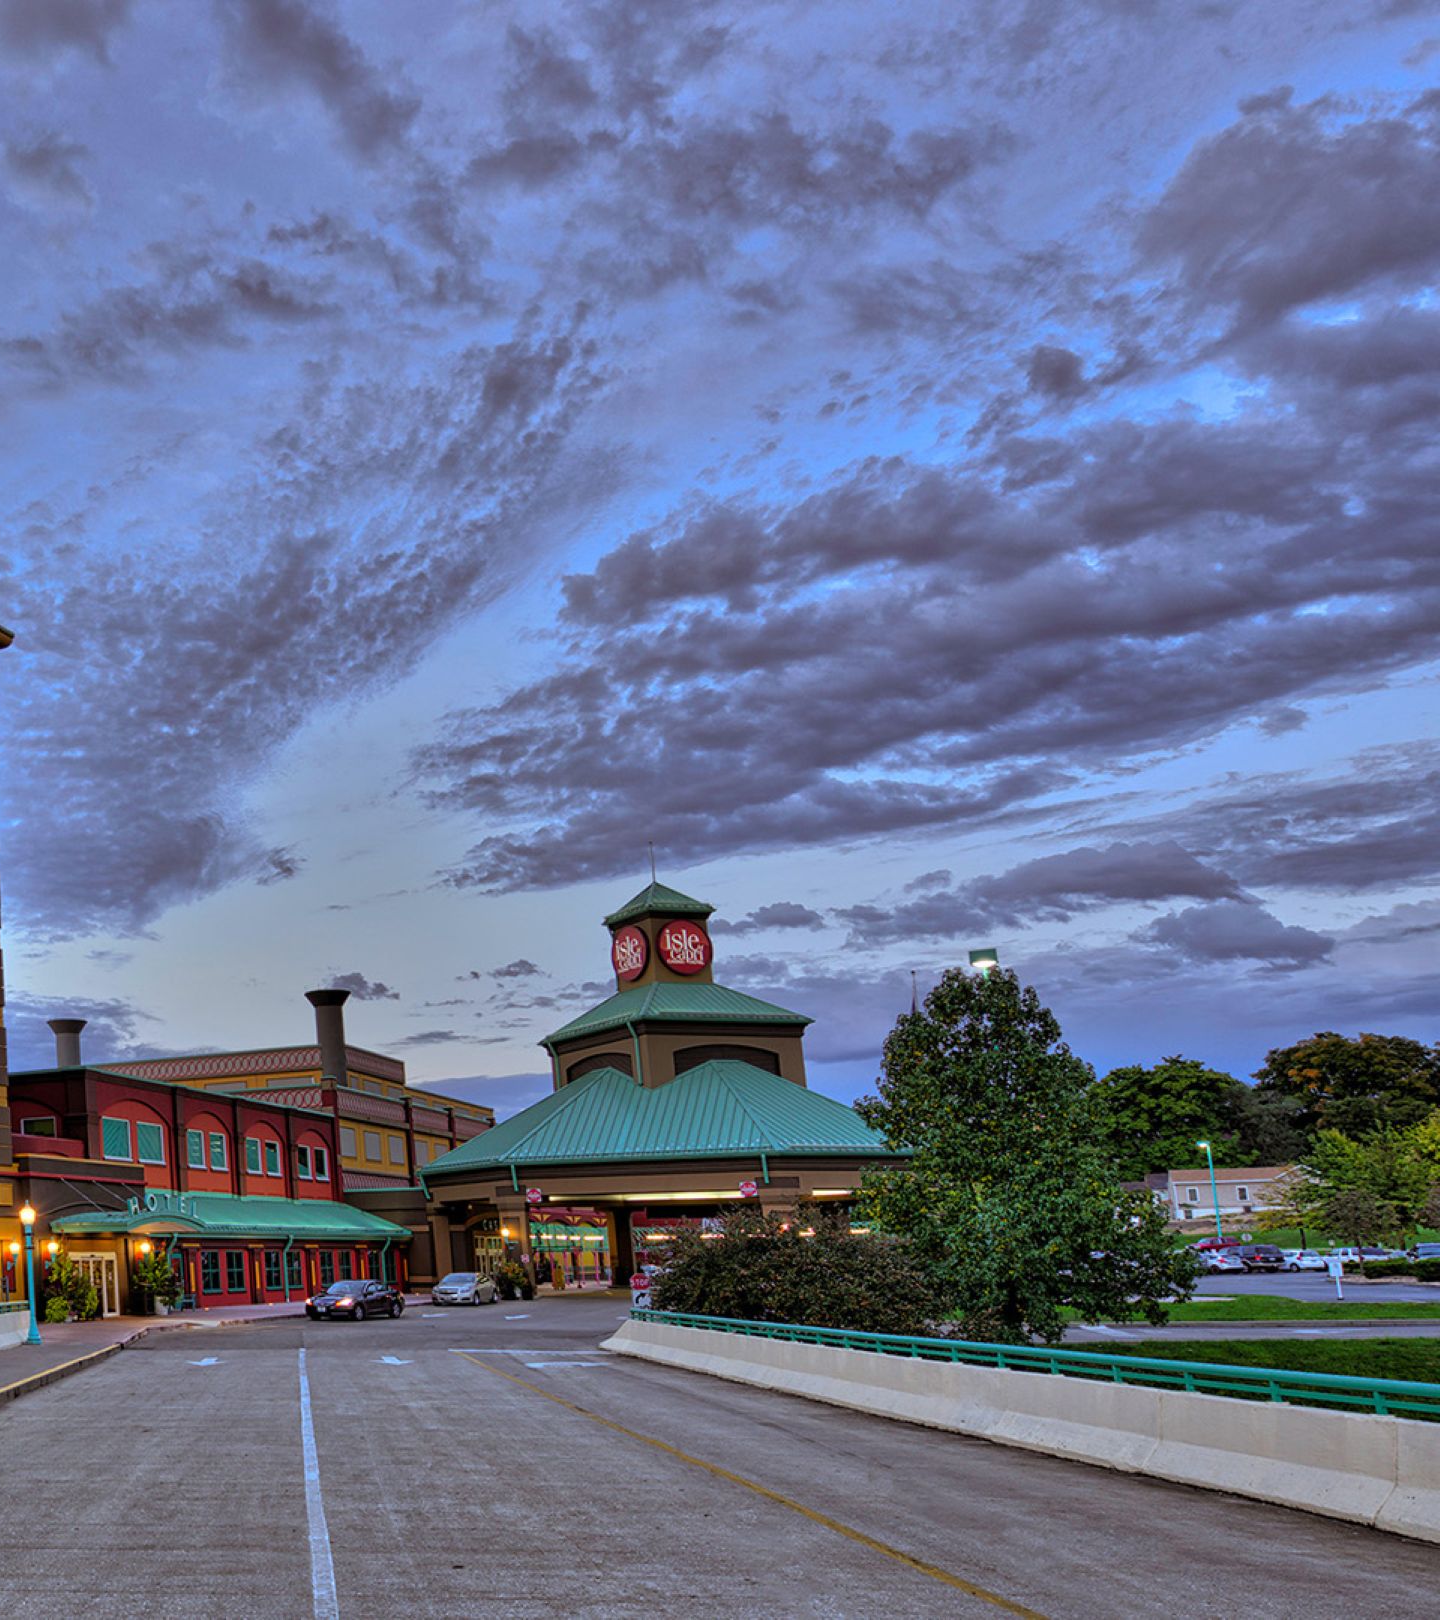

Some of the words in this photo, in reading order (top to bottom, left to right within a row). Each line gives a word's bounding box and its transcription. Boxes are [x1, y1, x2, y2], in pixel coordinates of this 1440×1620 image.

[616, 936, 640, 960] isle
[665, 929, 699, 951] isle
[127, 1193, 198, 1219] HOTEL
[630, 1278, 650, 1287] STOP
